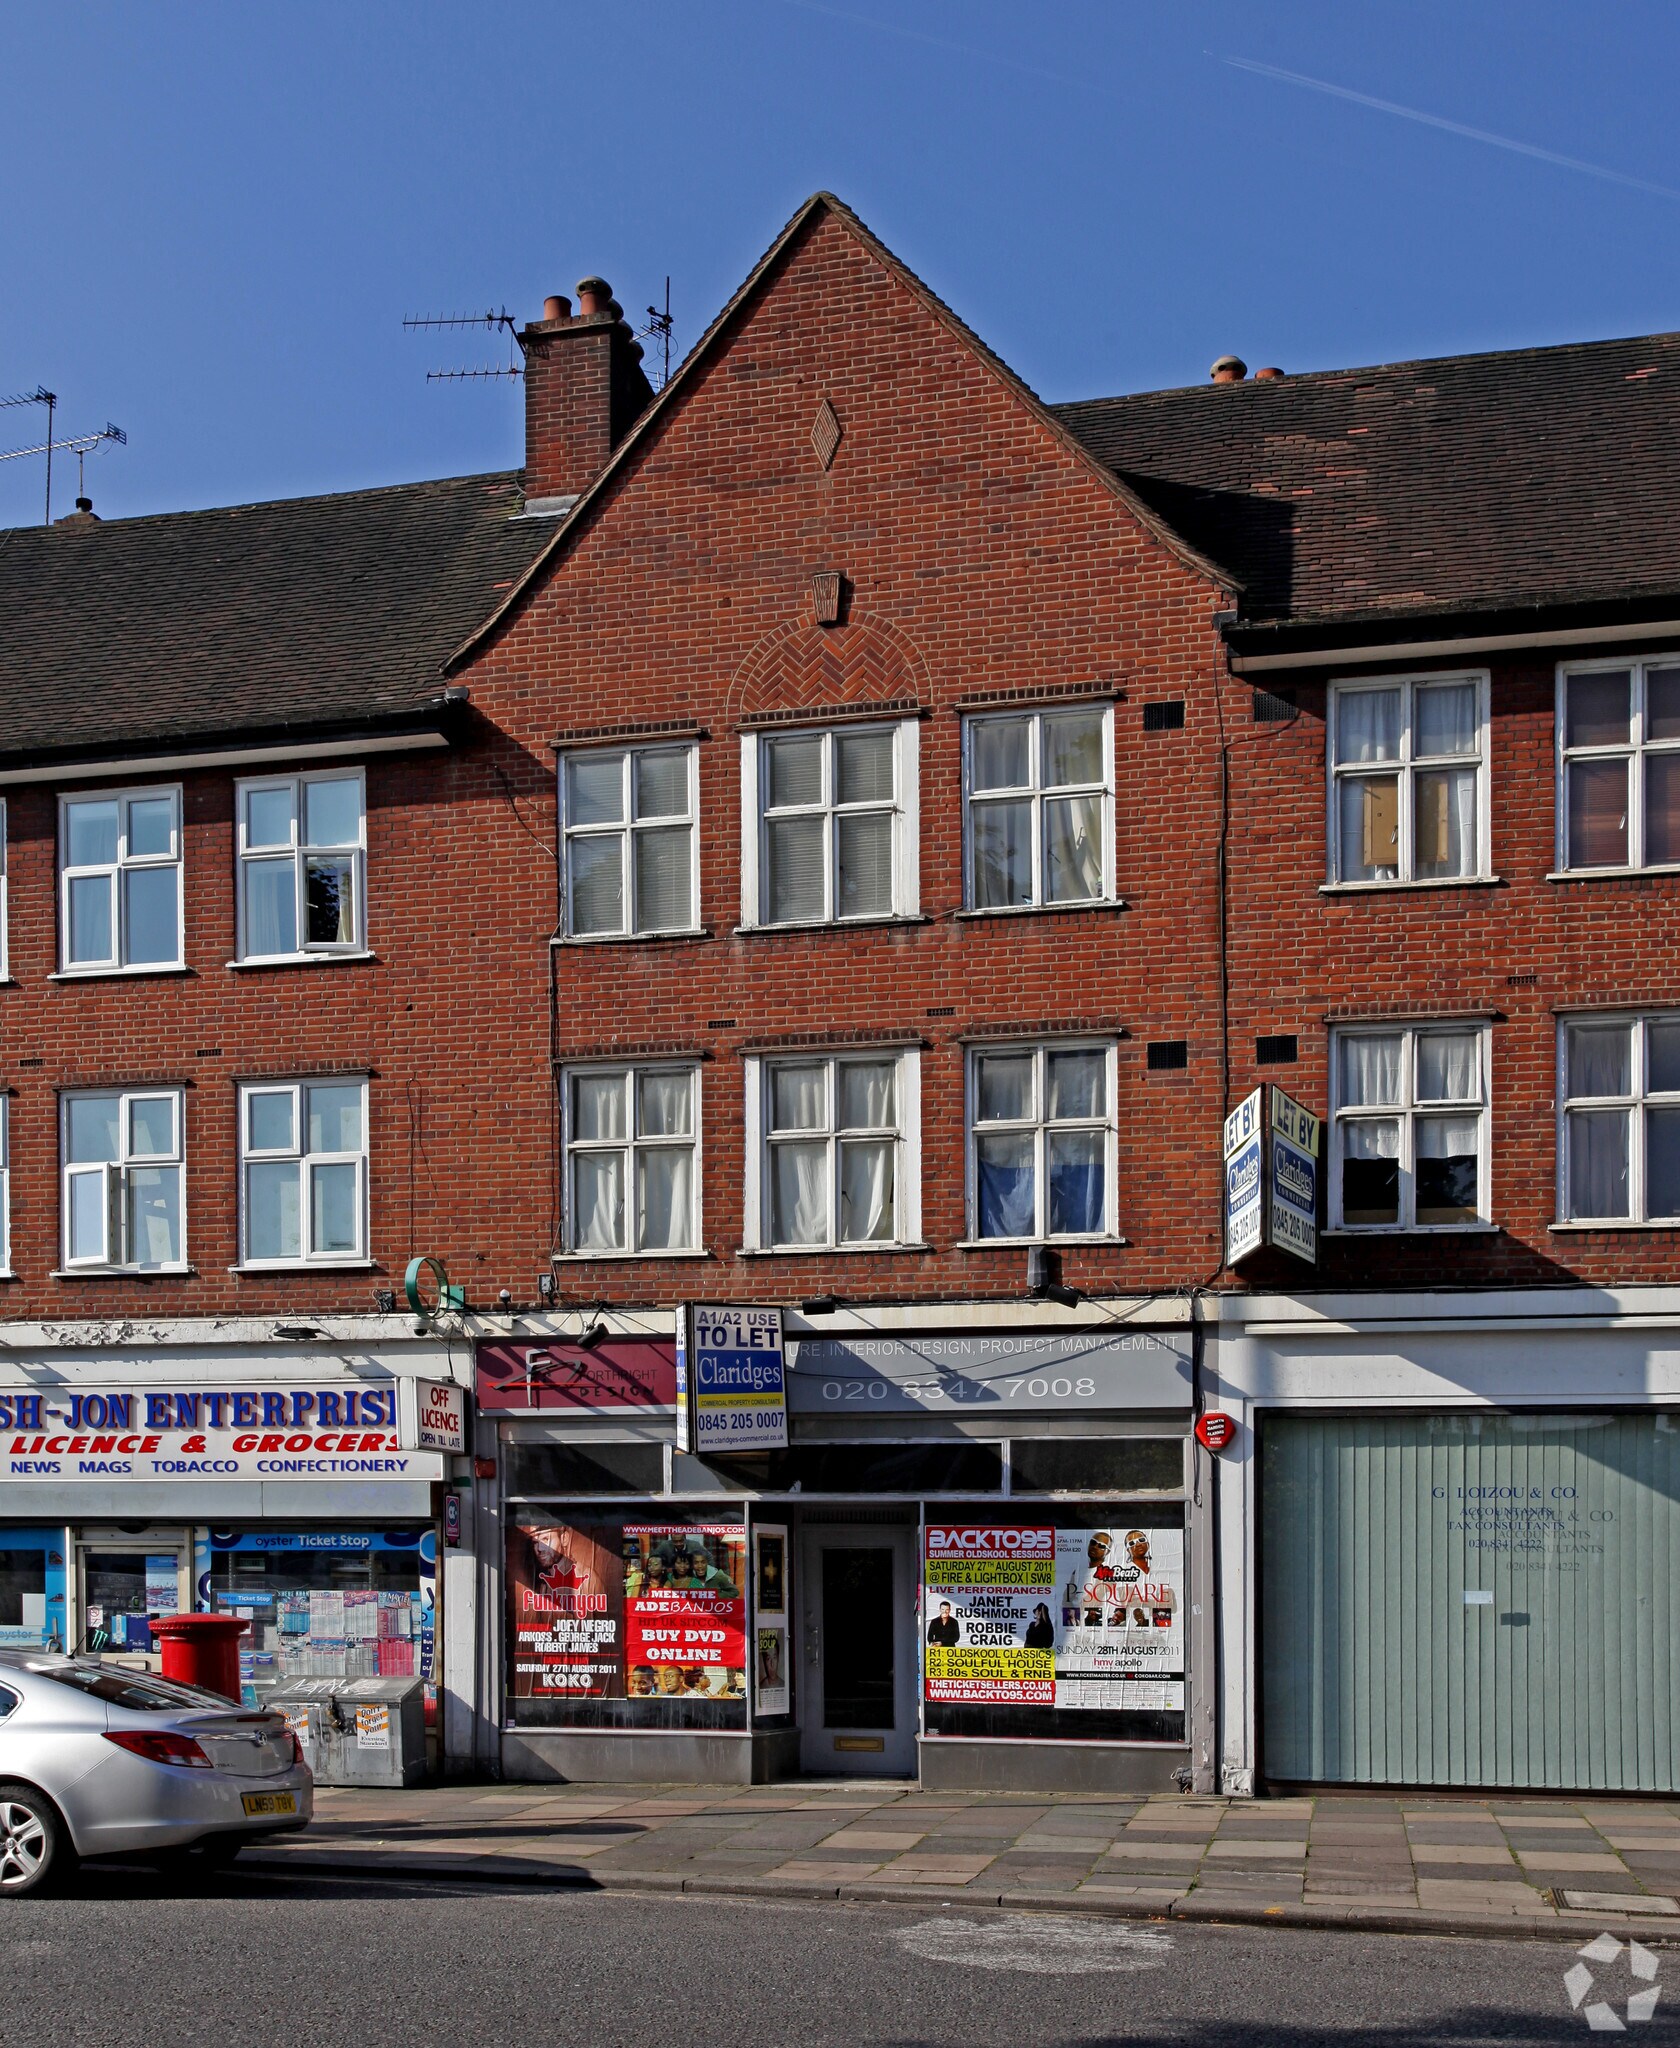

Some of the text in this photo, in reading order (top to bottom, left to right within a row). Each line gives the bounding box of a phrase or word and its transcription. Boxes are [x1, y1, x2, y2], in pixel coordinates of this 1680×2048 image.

[1226, 1095, 1256, 1152] LET BY
[1277, 1093, 1315, 1150] LET BY
[1230, 1154, 1258, 1194] Claridges
[1276, 1147, 1313, 1193] Claridges
[1272, 1204, 1315, 1249] 0845 205 0007
[698, 1311, 778, 1326] A1/A2 USE
[696, 1326, 728, 1347] TO
[736, 1327, 779, 1348] LET
[830, 1341, 905, 1357] INTERIOR
[911, 1340, 976, 1356] DESIGN,
[980, 1339, 1056, 1354] PROJECT
[1061, 1336, 1179, 1352] MANAGEMENT
[699, 1356, 781, 1390] Claridges
[579, 1385, 655, 1398] DESIGN
[822, 1377, 1097, 1400] 020 8347 7008
[430, 1386, 449, 1408] OFF
[421, 1407, 459, 1432] LICENCE
[698, 1413, 727, 1431] 0845
[730, 1412, 753, 1429] 205
[756, 1411, 784, 1429] 0007
[9, 1434, 163, 1454] LICENCE
[180, 1434, 207, 1453] &
[421, 1431, 460, 1448] OPEN TILL LATE
[700, 1433, 784, 1445] www.claridges-commercial.co.uk
[11, 1459, 408, 1474] NEWS MAGS TOBACCO CONFECTIONERY
[1456, 1486, 1525, 1499] LOIZOU
[1529, 1486, 1542, 1499] &
[1551, 1486, 1579, 1499] CO.
[1460, 1507, 1553, 1516] ACCOUNTANTS
[622, 1526, 745, 1534] WWW.MEETTHEADEBANJOS.COM
[1447, 1521, 1565, 1530] TAX CONSULTANTS
[255, 1535, 370, 1549] oyster Ticket Stop
[929, 1529, 1052, 1549] BACKTO95
[1468, 1540, 1488, 1548] 020
[1519, 1539, 1542, 1549] 4222
[929, 1550, 1052, 1559] SUMMER OLDSKOOL SESSIONS
[929, 1561, 975, 1571] SATURDAY
[995, 1561, 1032, 1572] AUGUST
[1034, 1561, 1052, 1572] 2011
[929, 1572, 1052, 1584] @ FIRE & LIGHTBOX SW8
[651, 1590, 716, 1599] MEET THE
[929, 1586, 1052, 1594] LIVE PERFORMANCES
[1065, 1582, 1170, 1608] P-SQUARE
[635, 1601, 734, 1613] ADEBANJOS
[969, 1596, 1014, 1608] JANET
[955, 1608, 1027, 1619] RUSHMORE
[552, 1619, 581, 1632] JOEY
[581, 1619, 616, 1633] NEGRO
[638, 1618, 729, 1628] HIT UK SITCOM
[966, 1622, 1017, 1634] ROBBIE
[518, 1631, 615, 1643] ARKOSS GEORGE JACK
[641, 1629, 726, 1642] BUY DVD
[759, 1629, 778, 1639] HAPPY
[970, 1634, 1013, 1646] CRAIG
[534, 1642, 599, 1653] ROBERT JAMES
[759, 1639, 777, 1649] SOUP
[1056, 1645, 1180, 1655] SUNDAY 28TH AUGUST 2011
[646, 1647, 722, 1661] ONLINE
[929, 1649, 1052, 1659] R1: OLDSKOOL CLASSICS
[516, 1663, 617, 1673] SATURDAY 27TH AUGUST 2011
[929, 1658, 1052, 1669] R2: SOULFUL HOUSE
[1093, 1657, 1143, 1668] hmv apollo
[929, 1668, 1052, 1678] R3: 80s SOUL & RNB
[542, 1673, 594, 1688] KOKO
[929, 1679, 1052, 1690] THETICKETSELLERS.CO.UK
[929, 1689, 1053, 1700] WWW.BACKTO95.COM
[360, 1713, 383, 1726] forget
[364, 1723, 382, 1736] your
[247, 1796, 275, 1812] LN59
